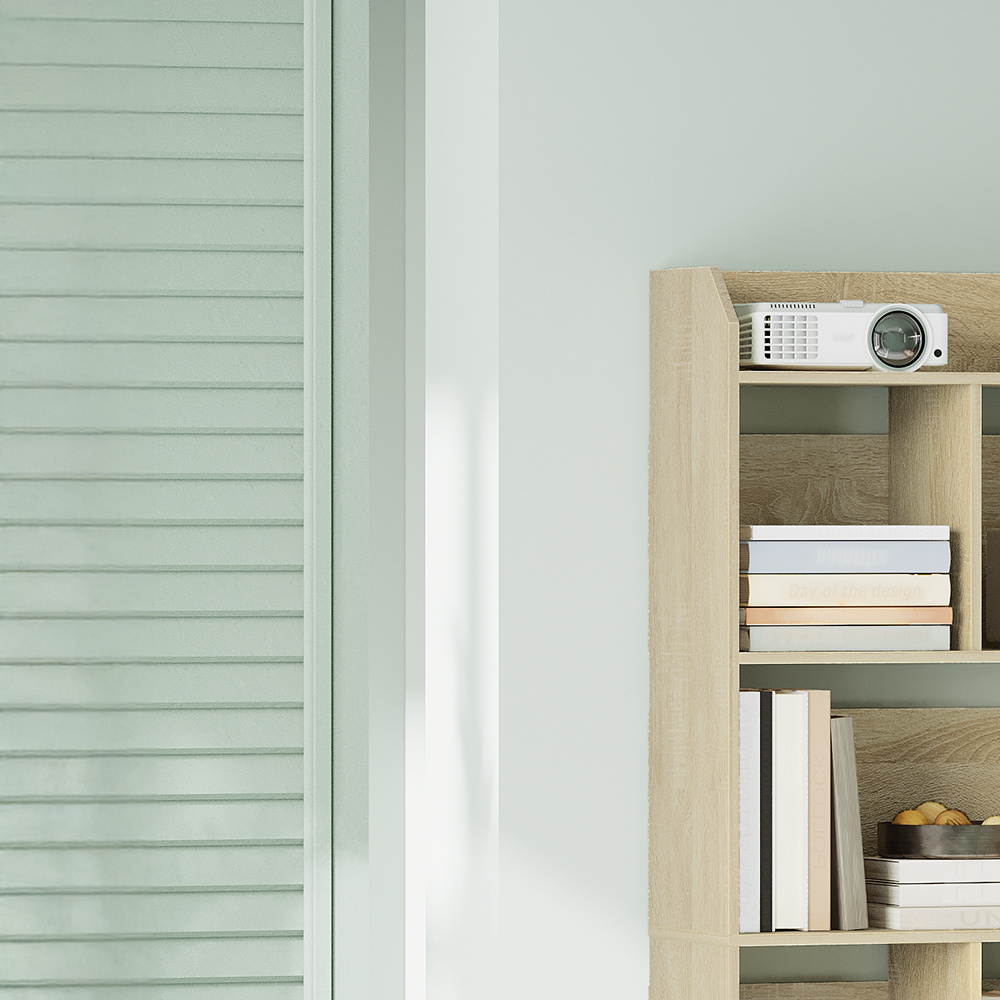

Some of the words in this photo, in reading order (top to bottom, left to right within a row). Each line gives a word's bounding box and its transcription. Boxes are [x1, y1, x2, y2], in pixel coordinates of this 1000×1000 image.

[788, 583, 818, 601] Day
[822, 582, 838, 598] of
[842, 582, 867, 598] the
[871, 582, 922, 601] design
